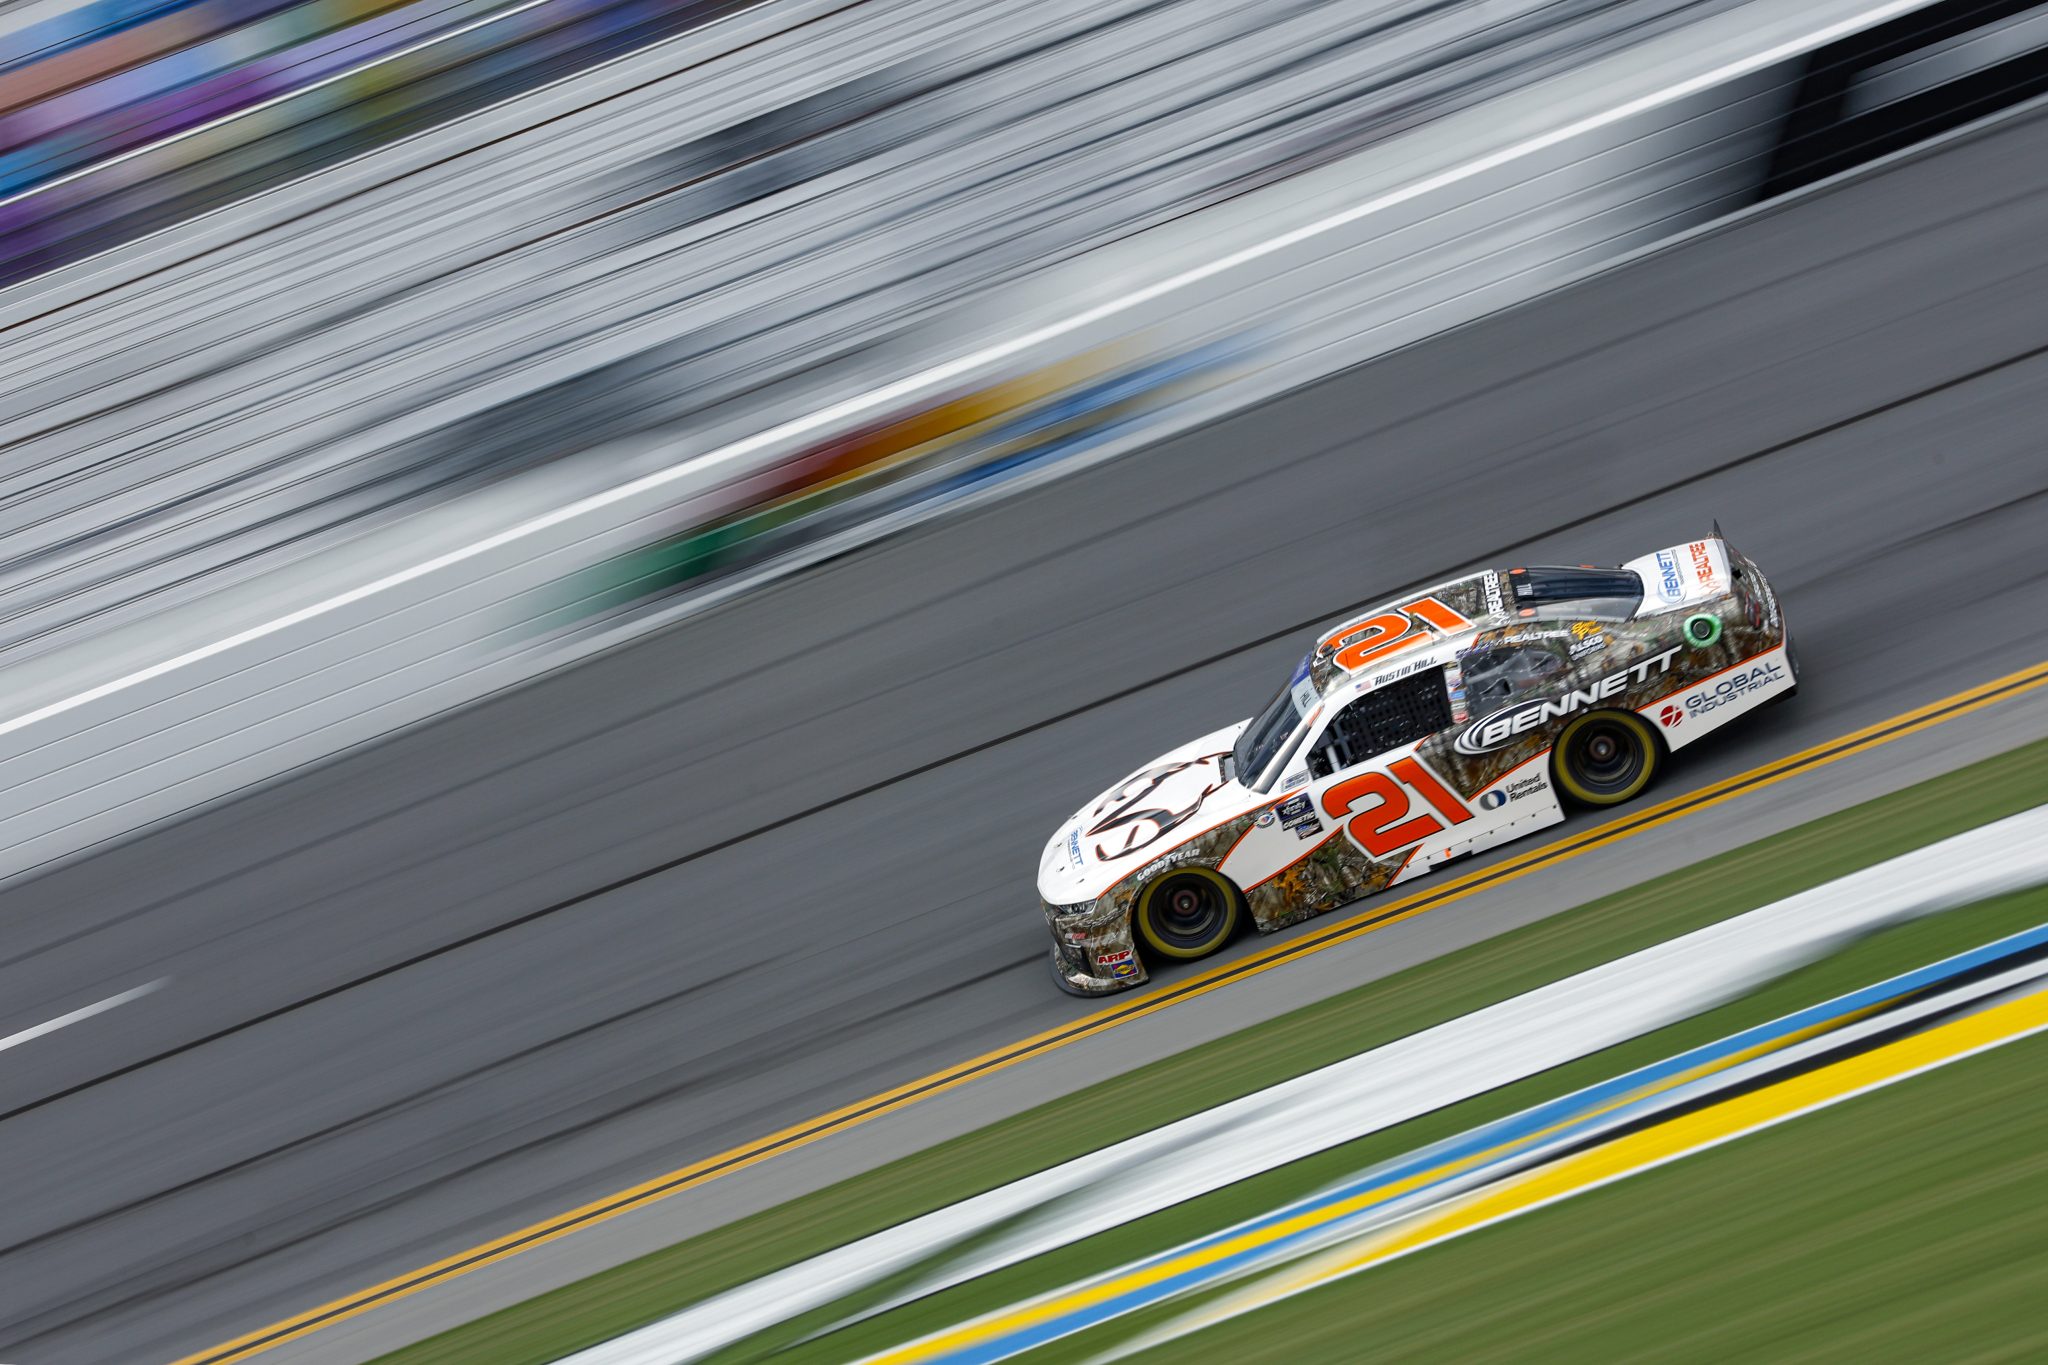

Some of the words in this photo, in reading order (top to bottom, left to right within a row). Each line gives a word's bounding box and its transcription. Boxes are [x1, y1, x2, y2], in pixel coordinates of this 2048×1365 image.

[1656, 552, 1682, 597] BENNETT
[1688, 542, 1713, 583] REALTREE
[1483, 572, 1504, 615] REALTREE
[1317, 597, 1476, 674] 21
[1504, 629, 1570, 645] REALTREE
[1374, 664, 1411, 686] AUSTIN
[1413, 656, 1438, 670] HILL
[1685, 662, 1781, 709] GLOBAL
[1481, 644, 1683, 748] BENNETT
[1689, 672, 1785, 719] INDUSTRIAL
[1505, 772, 1541, 793] United
[1510, 781, 1548, 802] Rentals
[1321, 755, 1475, 857] 21
[1136, 848, 1200, 881] GOODYEAR
[1098, 950, 1131, 964] ARP
